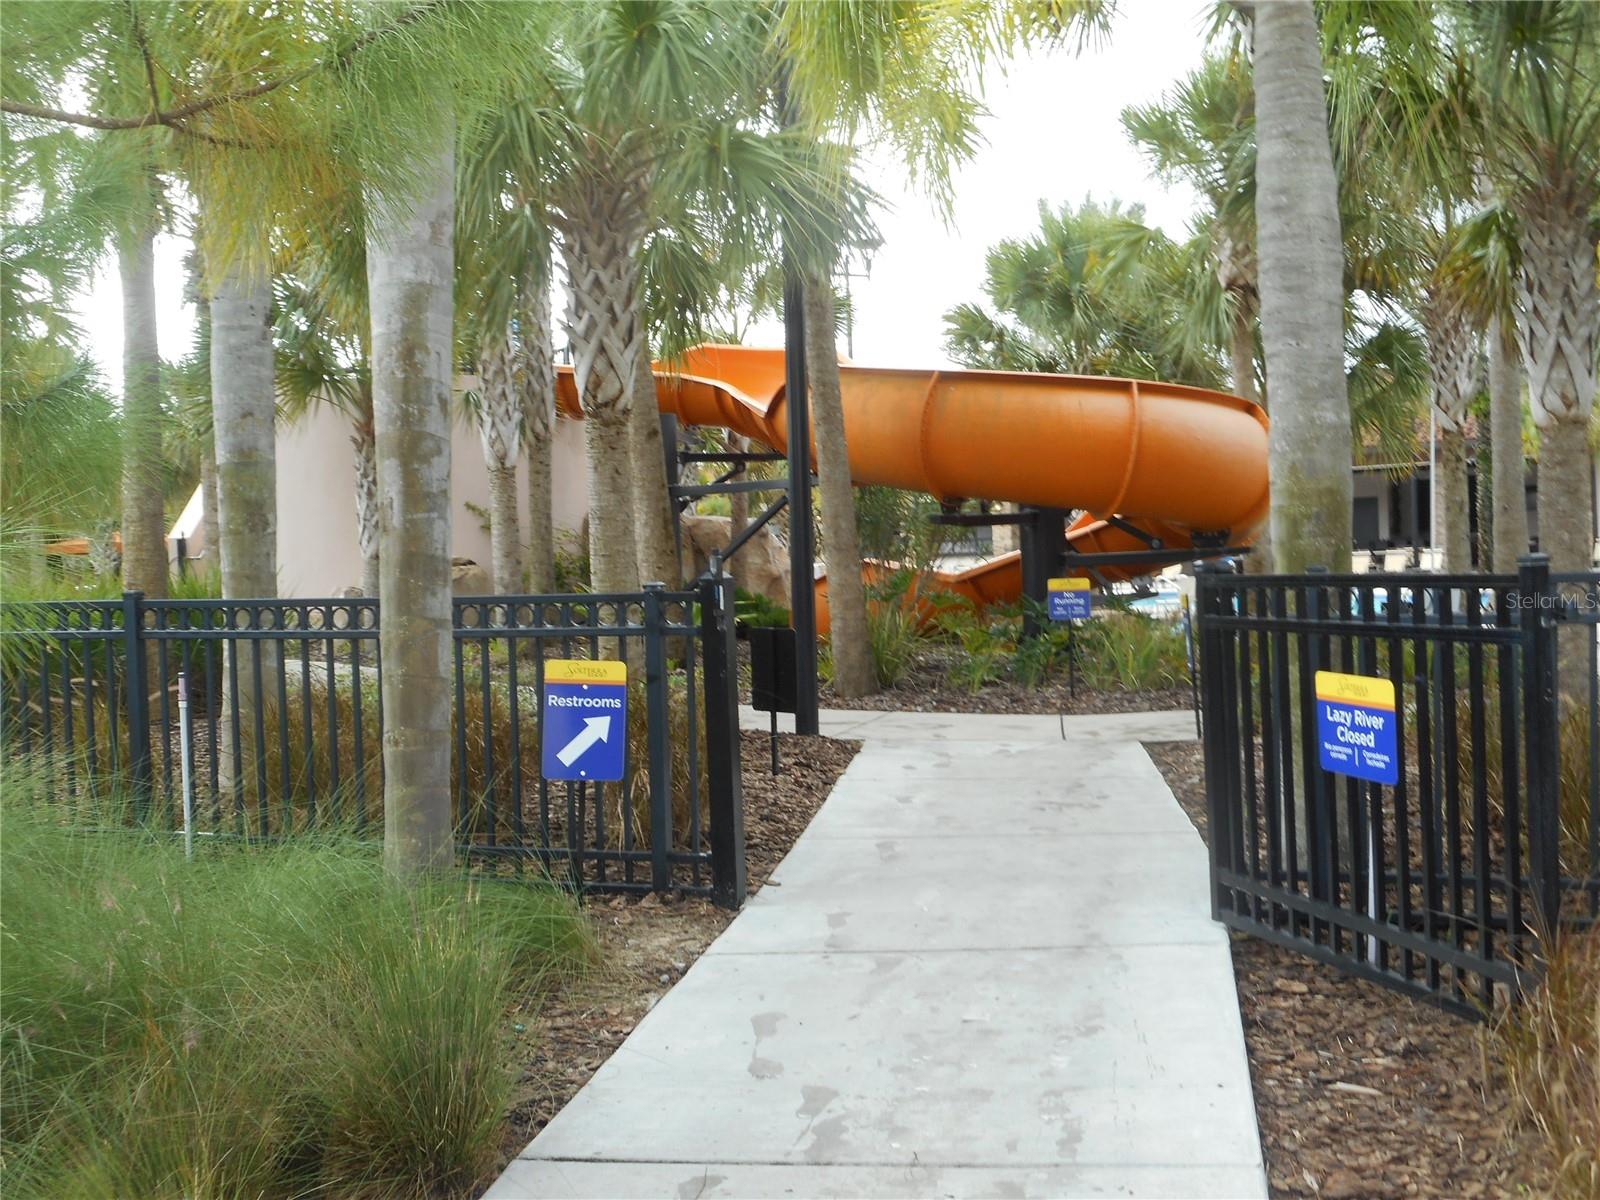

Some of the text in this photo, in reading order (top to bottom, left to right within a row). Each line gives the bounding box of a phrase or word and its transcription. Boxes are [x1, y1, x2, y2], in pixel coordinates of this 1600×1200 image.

[548, 694, 622, 709] Restrooms
[1326, 705, 1385, 731] Lazy River
[1336, 725, 1376, 748] Closed
